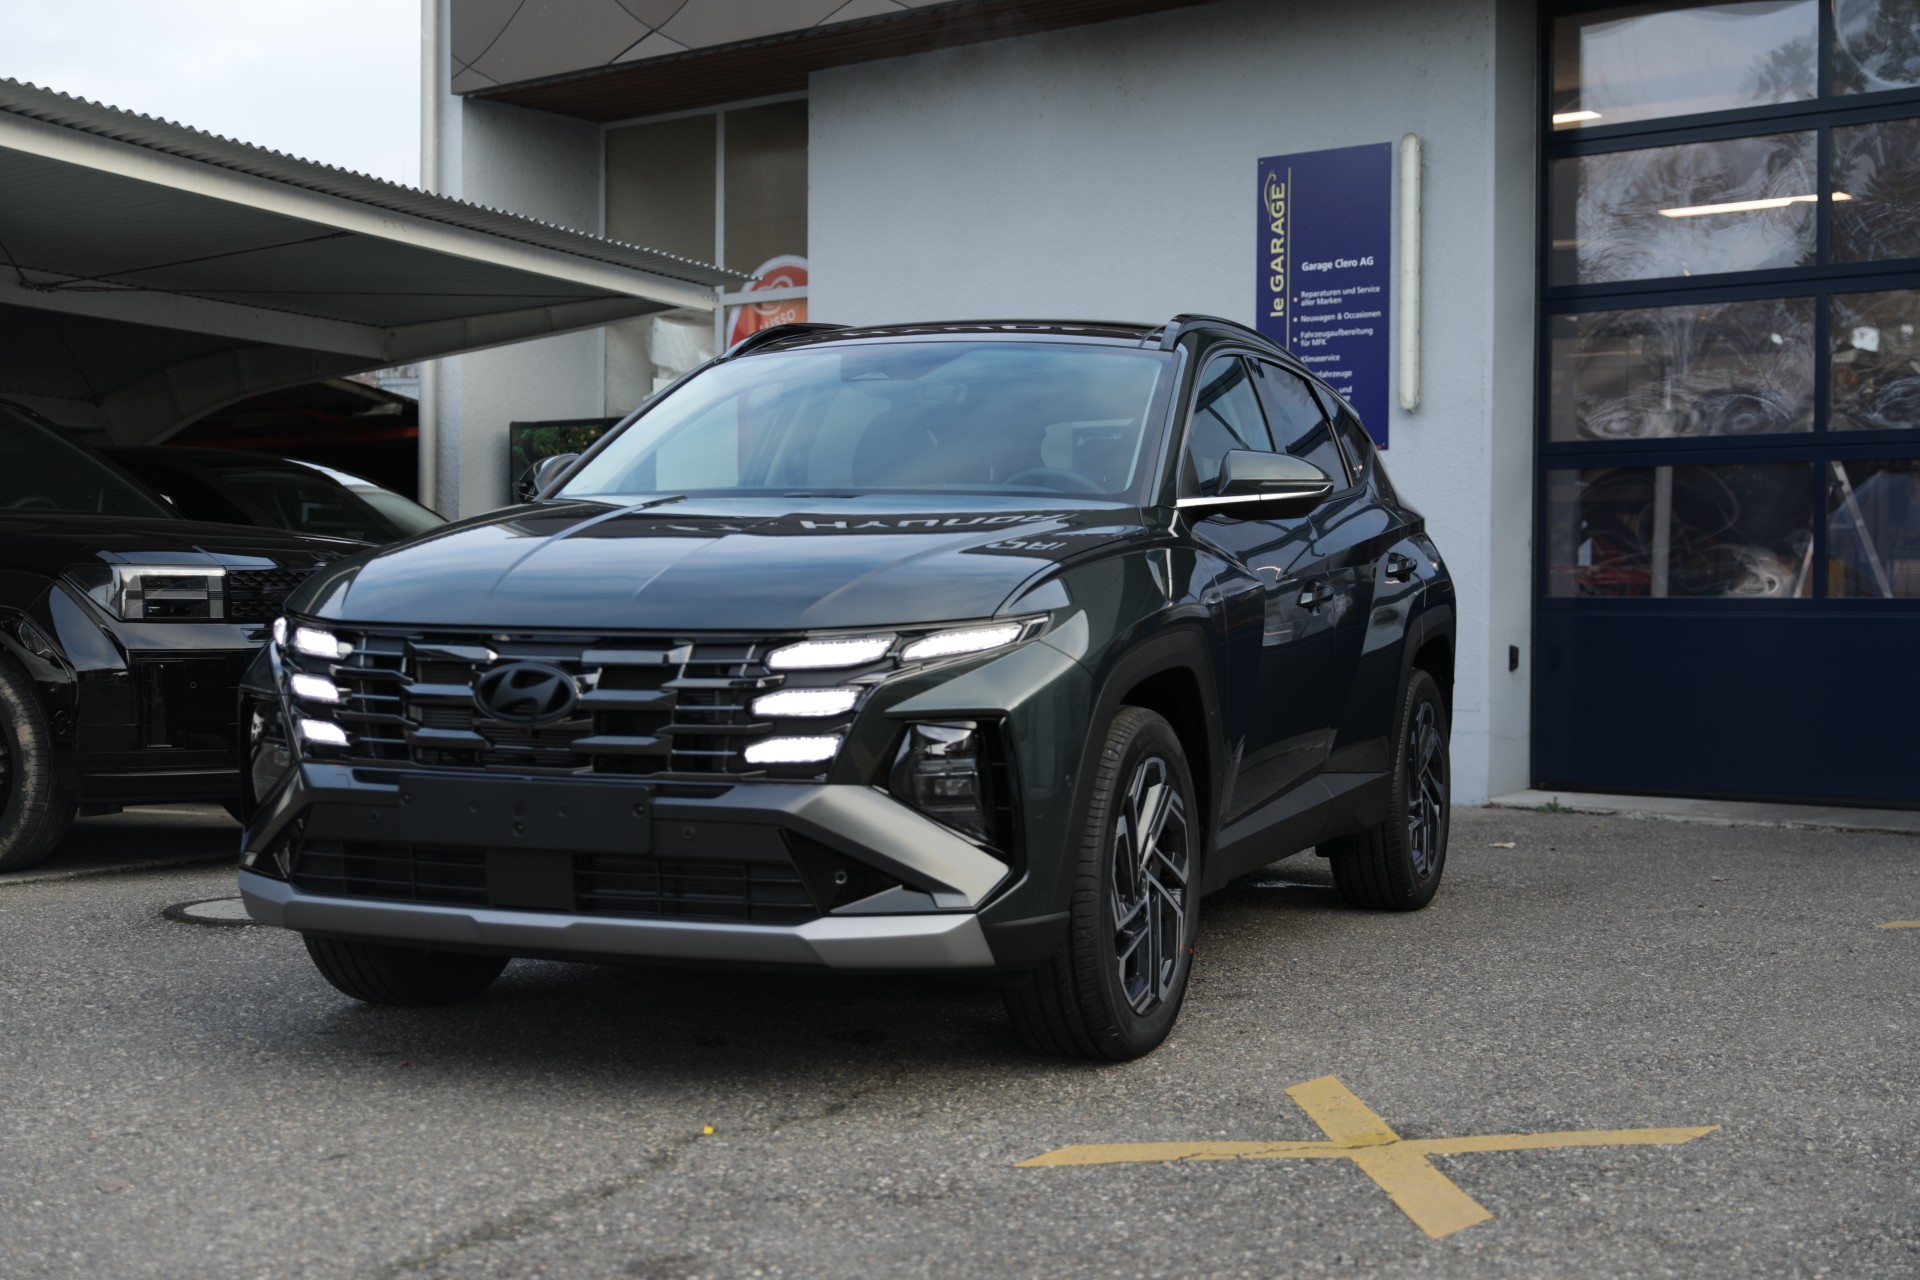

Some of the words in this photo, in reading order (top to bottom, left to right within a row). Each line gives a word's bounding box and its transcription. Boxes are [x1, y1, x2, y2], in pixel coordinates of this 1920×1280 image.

[1270, 182, 1285, 293] GARAGE
[1301, 261, 1333, 272] Garage
[1334, 258, 1358, 269] Clero
[1359, 256, 1374, 266] AG
[1300, 289, 1341, 299] Reparaturen
[1342, 286, 1356, 295] und
[1357, 284, 1381, 294] Service
[1269, 297, 1284, 318] le
[1300, 299, 1315, 307] aller
[1316, 297, 1342, 305] Marken
[1300, 313, 1335, 323] Neuwagen
[1337, 312, 1342, 320] &
[1343, 310, 1382, 319] Occasionen
[1300, 327, 1374, 339] Fahrzeugaufbereitung
[1300, 338, 1311, 347] für
[1311, 338, 1327, 346] MFK
